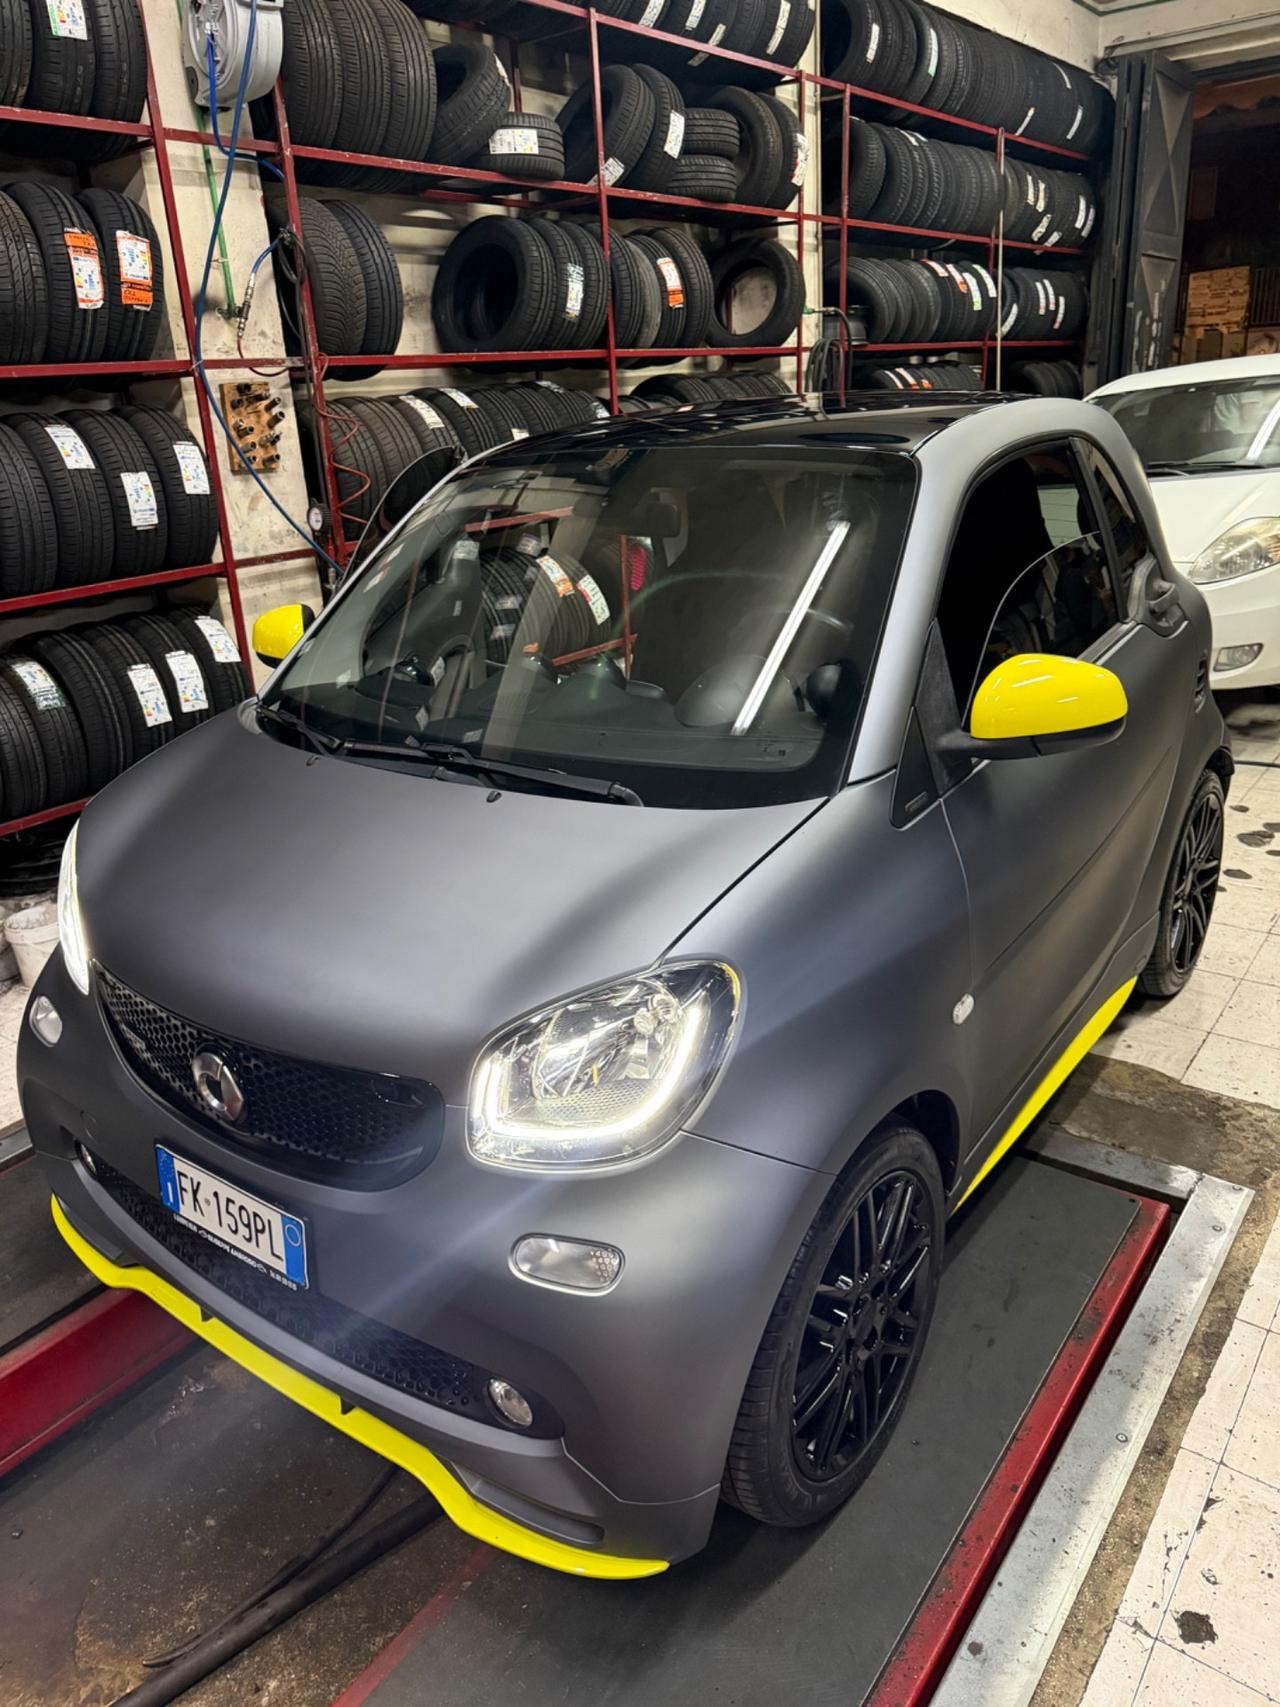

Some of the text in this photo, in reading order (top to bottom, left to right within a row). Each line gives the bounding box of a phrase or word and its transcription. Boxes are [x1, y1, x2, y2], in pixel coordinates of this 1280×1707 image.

[167, 1182, 174, 1203] I
[177, 1170, 284, 1262] FK 159PL
